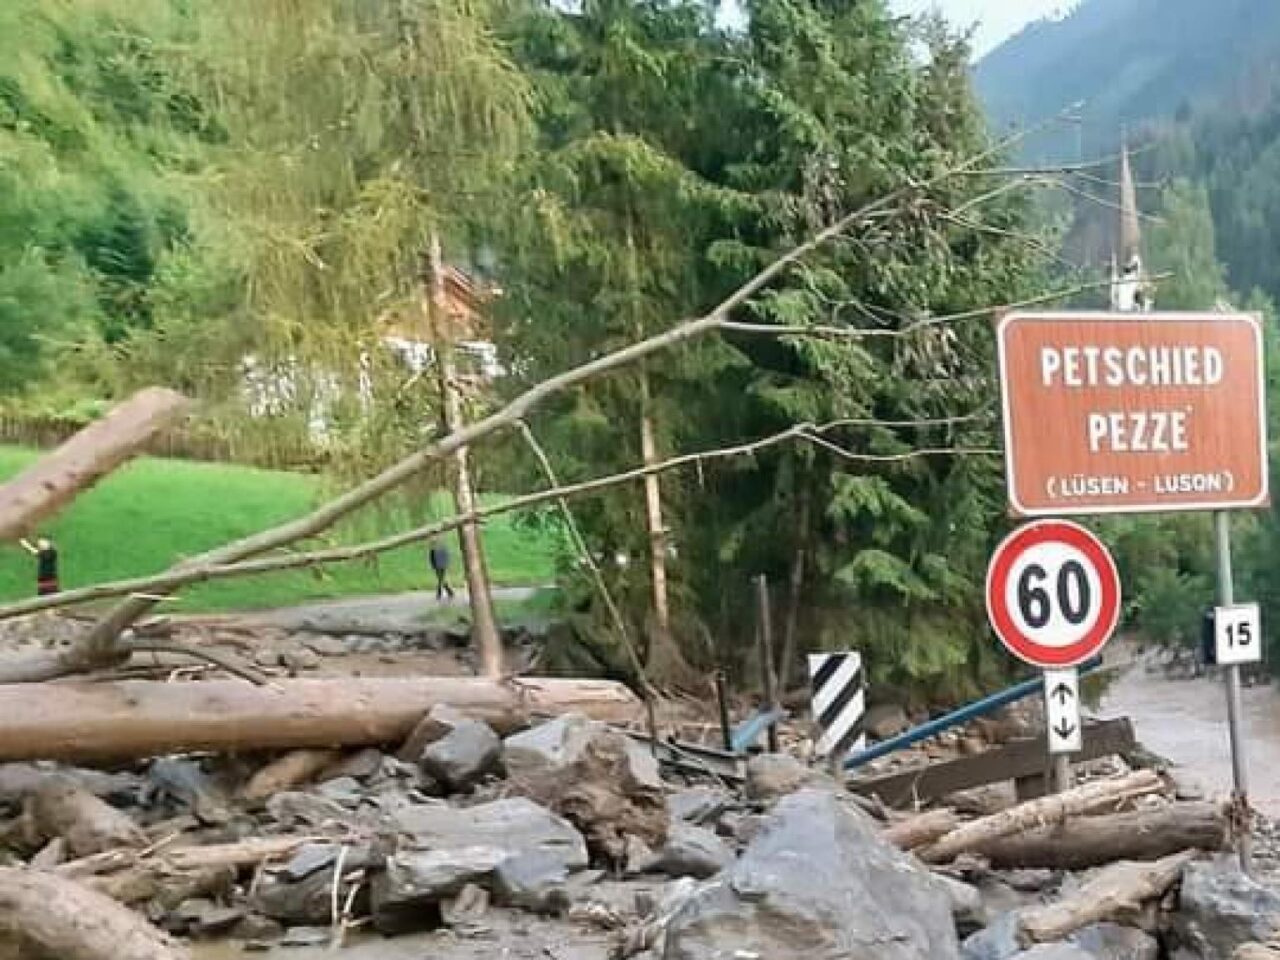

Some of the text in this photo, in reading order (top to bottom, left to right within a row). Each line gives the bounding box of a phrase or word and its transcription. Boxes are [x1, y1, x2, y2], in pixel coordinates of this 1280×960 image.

[1040, 347, 1224, 387] PETSCHIED
[1017, 559, 1092, 629] 60
[1225, 622, 1252, 648] 15
